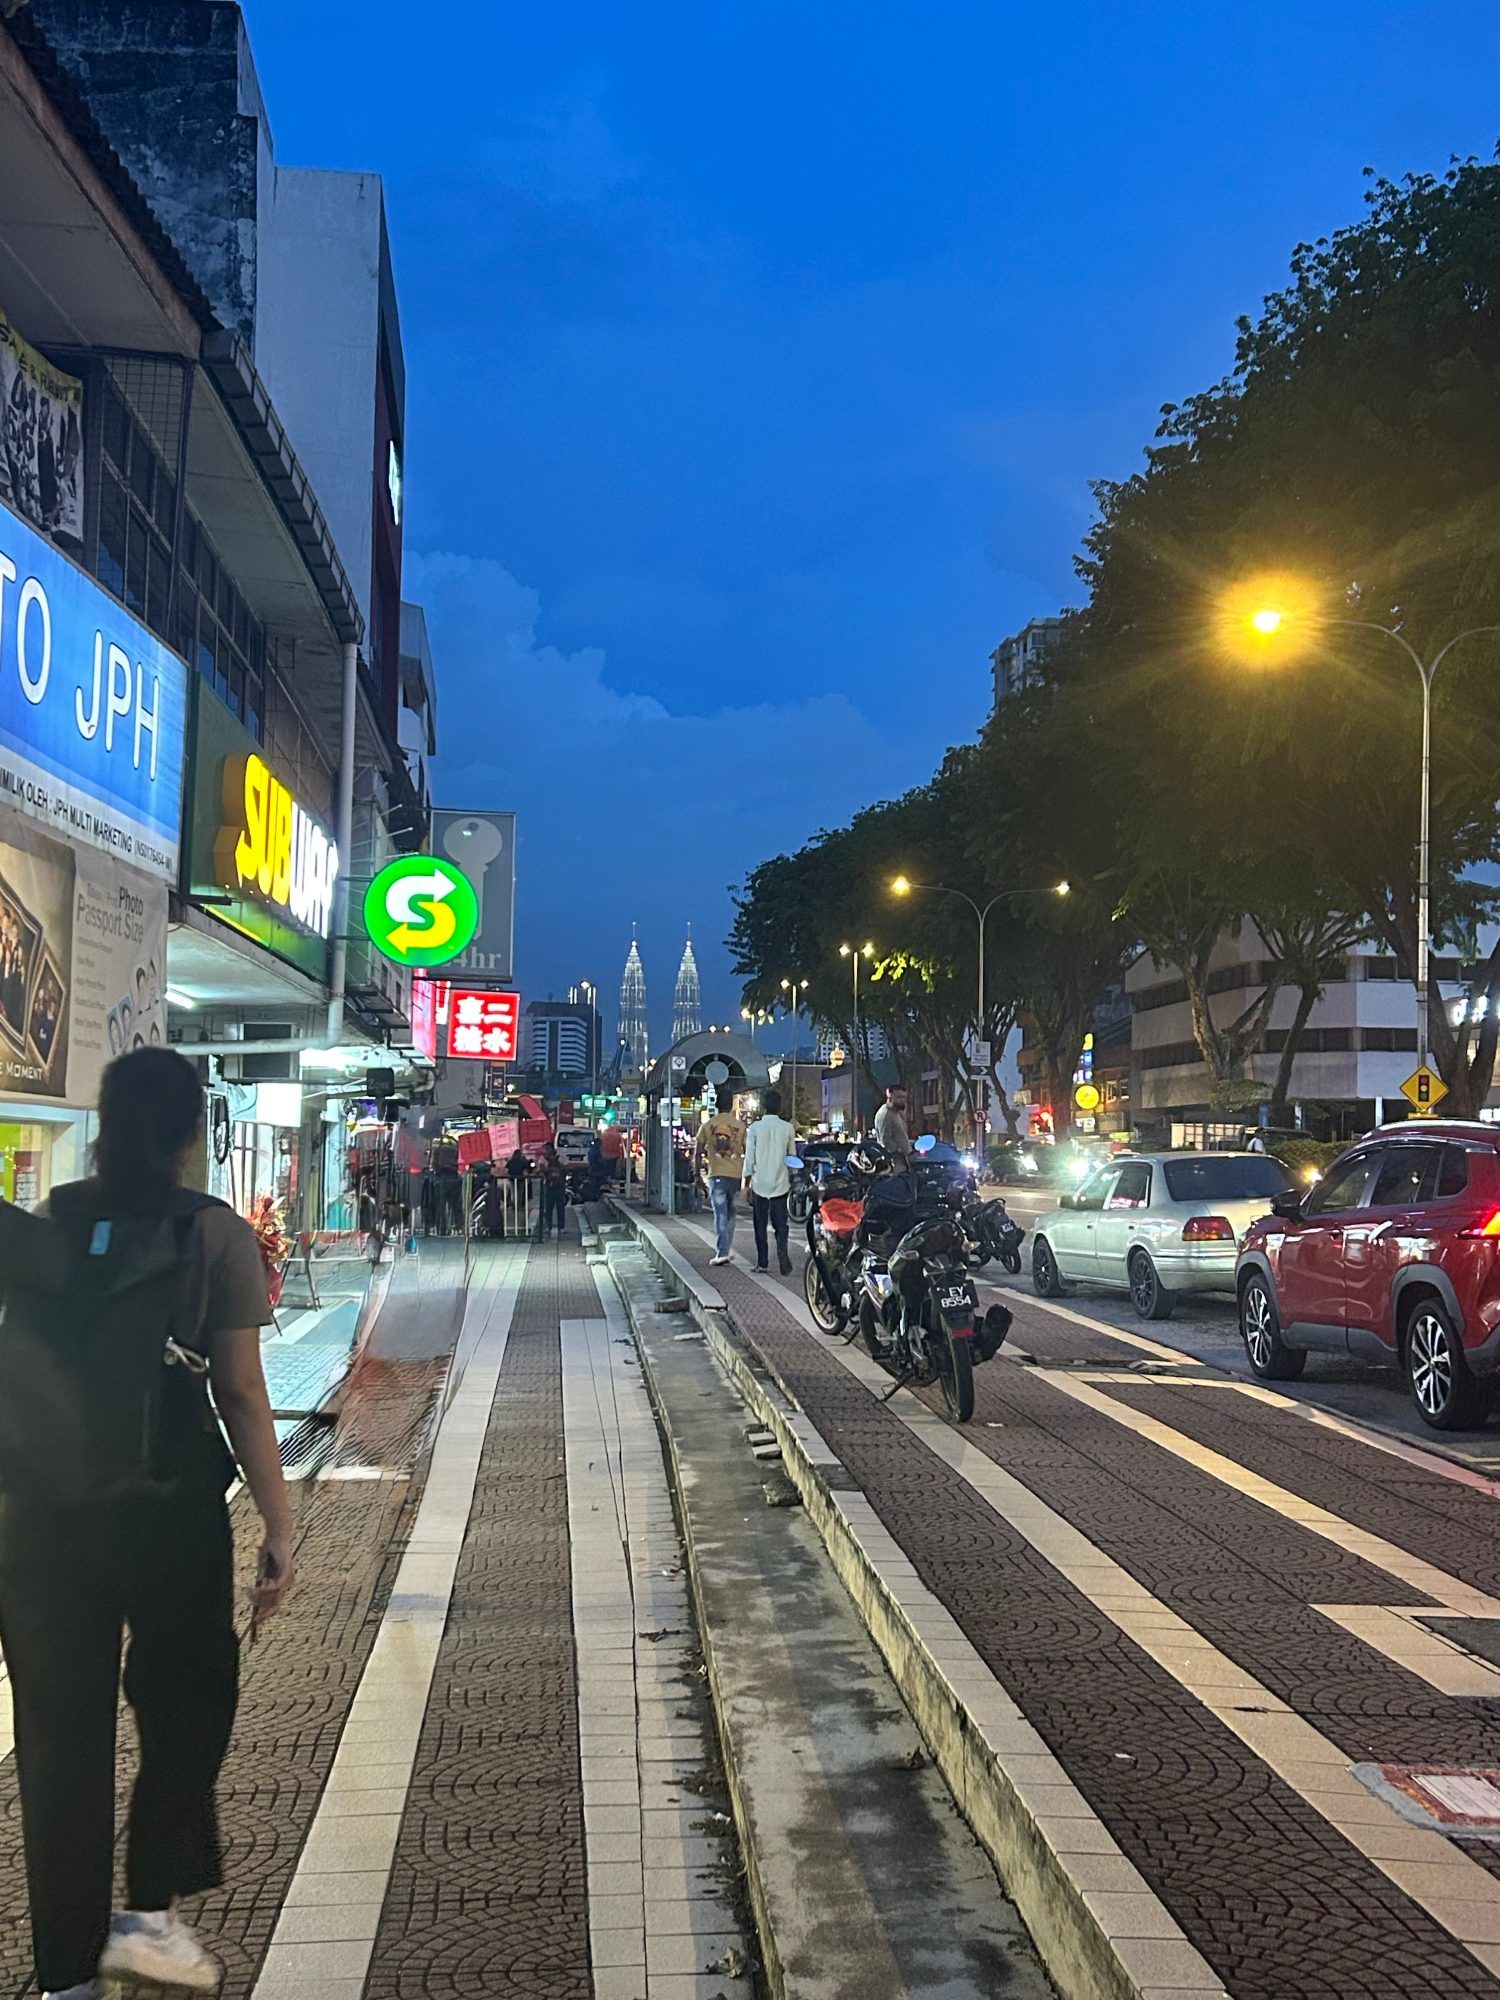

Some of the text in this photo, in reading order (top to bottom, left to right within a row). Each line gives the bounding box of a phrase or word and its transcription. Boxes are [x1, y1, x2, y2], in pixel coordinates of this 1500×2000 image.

[75, 629, 160, 781] JPH
[27, 782, 48, 811] OLEH
[53, 797, 69, 821] JPH
[70, 807, 92, 833] MULTI
[94, 818, 132, 852] MARKETING
[235, 753, 339, 940] SUBWAY
[119, 886, 144, 916] Photo
[77, 893, 122, 937] Passport
[124, 914, 145, 944] Size
[443, 946, 501, 969] 4hr
[6, 1061, 42, 1080] MOMENT
[941, 1295, 971, 1308] 8554
[949, 1286, 964, 1297] EY
